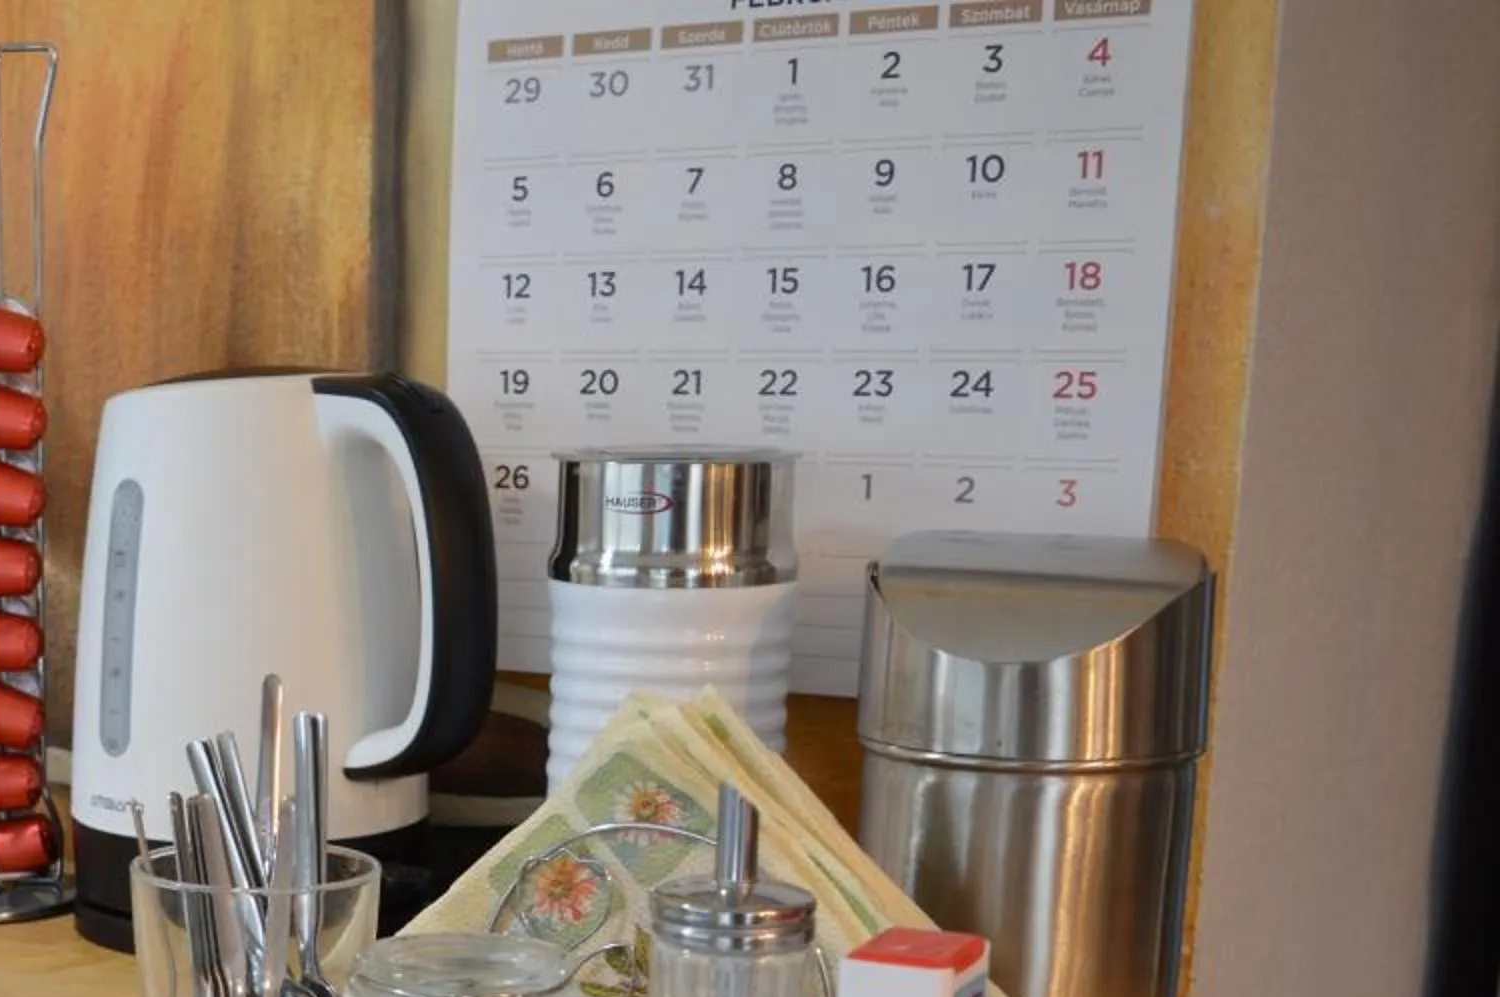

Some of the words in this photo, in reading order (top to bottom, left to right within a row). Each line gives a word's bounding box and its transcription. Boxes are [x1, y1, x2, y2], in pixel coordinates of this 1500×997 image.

[960, 5, 1031, 25] Szombat
[1064, 0, 1141, 14] Vasárnap
[504, 76, 542, 105] 29
[589, 69, 630, 98] 30
[683, 63, 715, 93] 31
[787, 57, 798, 85] 1
[880, 51, 901, 80] 2
[982, 44, 1004, 73] 3
[1087, 37, 1112, 67] 4
[511, 175, 529, 202] 5
[596, 171, 615, 198] 6
[686, 167, 705, 195] 7
[777, 163, 798, 191] 8
[874, 159, 896, 187] 9
[966, 154, 1005, 183] 10
[1077, 149, 1104, 180] 11
[502, 273, 531, 299] 12
[587, 271, 616, 298] 13
[675, 269, 707, 296] 14
[767, 267, 799, 295] 15
[861, 265, 896, 293] 16
[962, 263, 997, 292] 17
[1064, 261, 1102, 291] 18
[499, 369, 530, 395] 19
[579, 369, 619, 396] 20
[672, 369, 702, 396] 21
[758, 369, 798, 397] 22
[852, 369, 894, 398] 23
[949, 370, 994, 398] 24
[1052, 370, 1098, 400] 25
[493, 464, 530, 490] 26
[861, 473, 872, 501] 1
[954, 476, 975, 504] 2
[1056, 479, 1077, 508] 3
